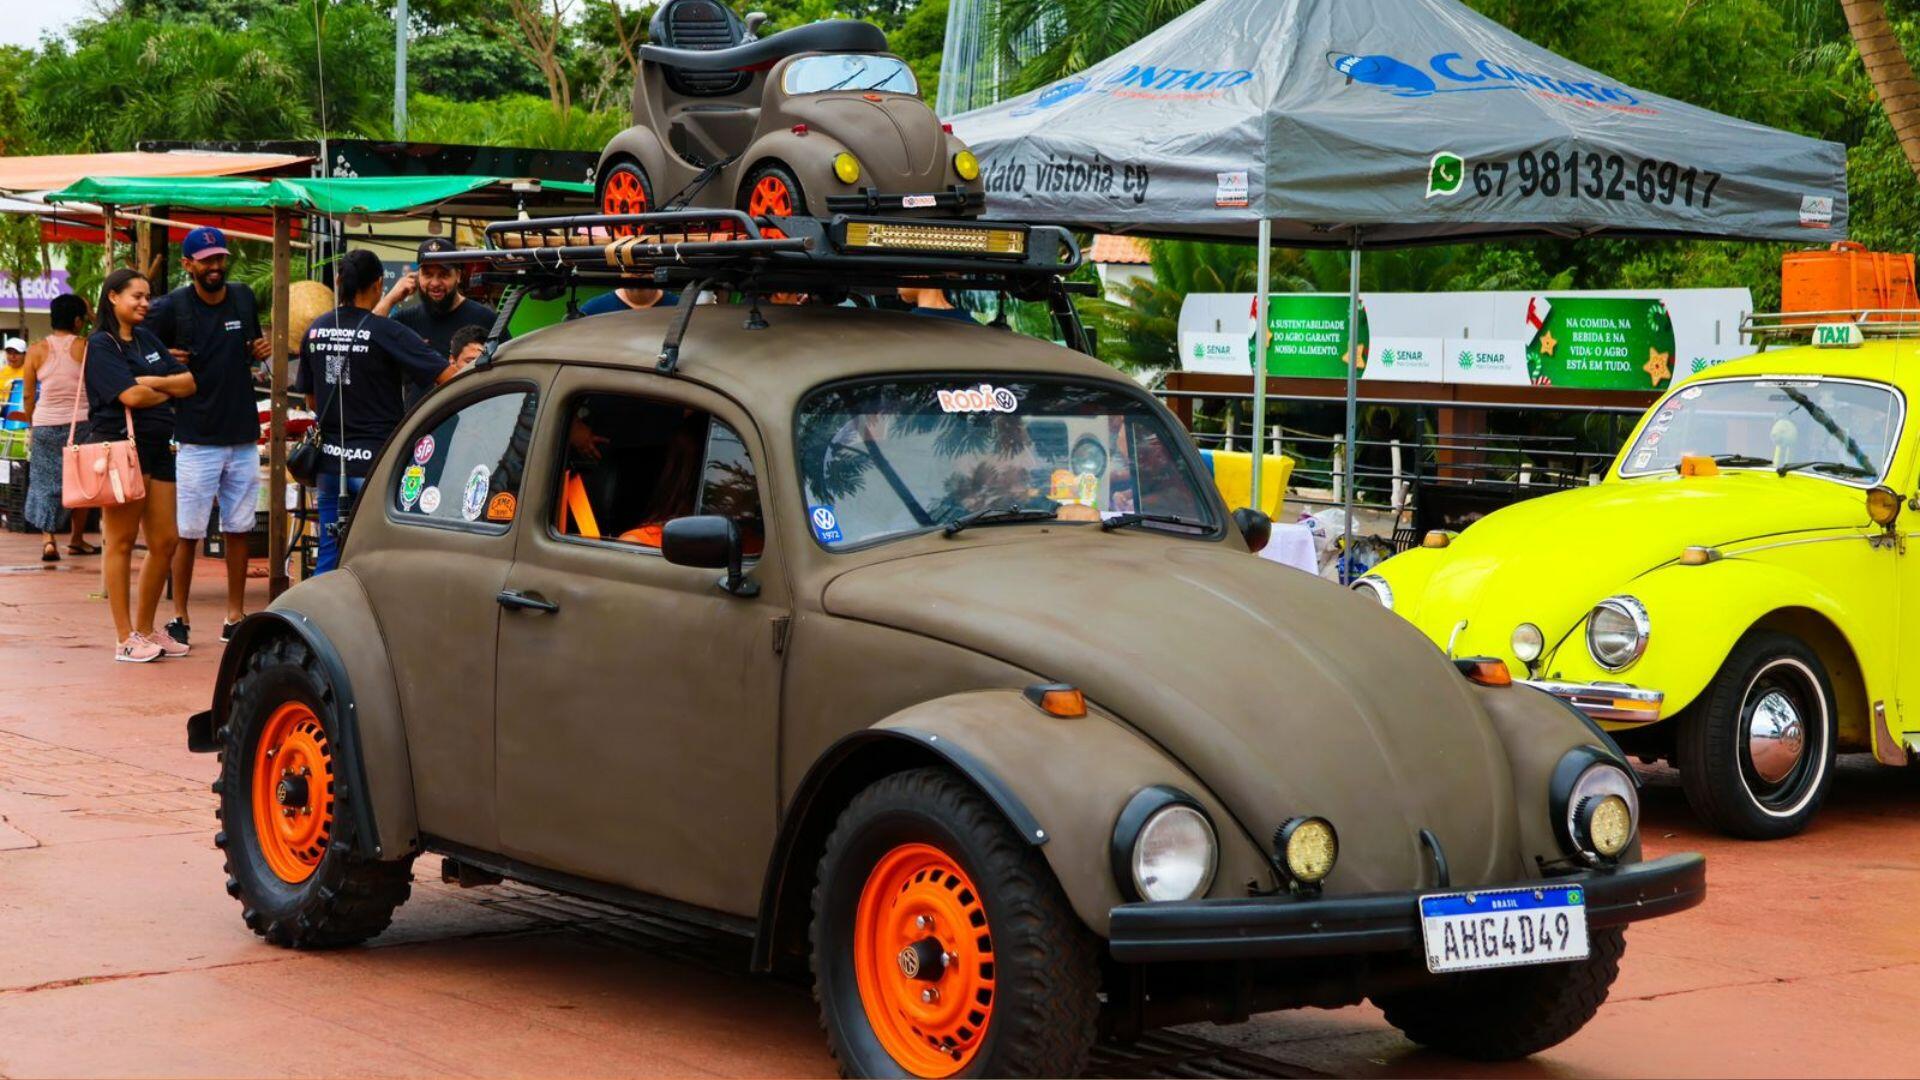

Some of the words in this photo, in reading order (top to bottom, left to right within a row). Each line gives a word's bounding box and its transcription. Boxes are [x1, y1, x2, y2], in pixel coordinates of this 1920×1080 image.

[981, 153, 1149, 204] tato_vistoria_cg
[1473, 162, 1509, 197] 67
[1517, 150, 1722, 208] 98132-6917
[1275, 319, 1345, 330] SUSTENTABILIDADE
[1566, 318, 1578, 328] NA
[1579, 318, 1617, 329] COMIDA,
[1619, 319, 1632, 329] NA
[1274, 332, 1284, 341] DO
[1285, 332, 1304, 342] AGRO
[1305, 333, 1340, 343] GARANTE
[1572, 332, 1604, 343] BEBIDA
[1605, 332, 1611, 343] E
[1613, 333, 1626, 343] NA
[1817, 326, 1850, 343] TAXI
[1206, 344, 1231, 354] SENAR
[1274, 345, 1297, 354] NOSSO
[1298, 345, 1339, 356] ALIMENTO.
[1594, 346, 1602, 357] O
[1603, 346, 1628, 357] AGRO
[1396, 351, 1423, 360] SENAR
[1476, 353, 1505, 363] SENAR
[1566, 358, 1587, 370] ESTÁ
[1589, 360, 1602, 371] EM
[1605, 361, 1632, 372] TUDO.
[416, 439, 433, 459] STP
[1491, 899, 1519, 910] BRASIL
[1444, 912, 1570, 962] AHG4D49
